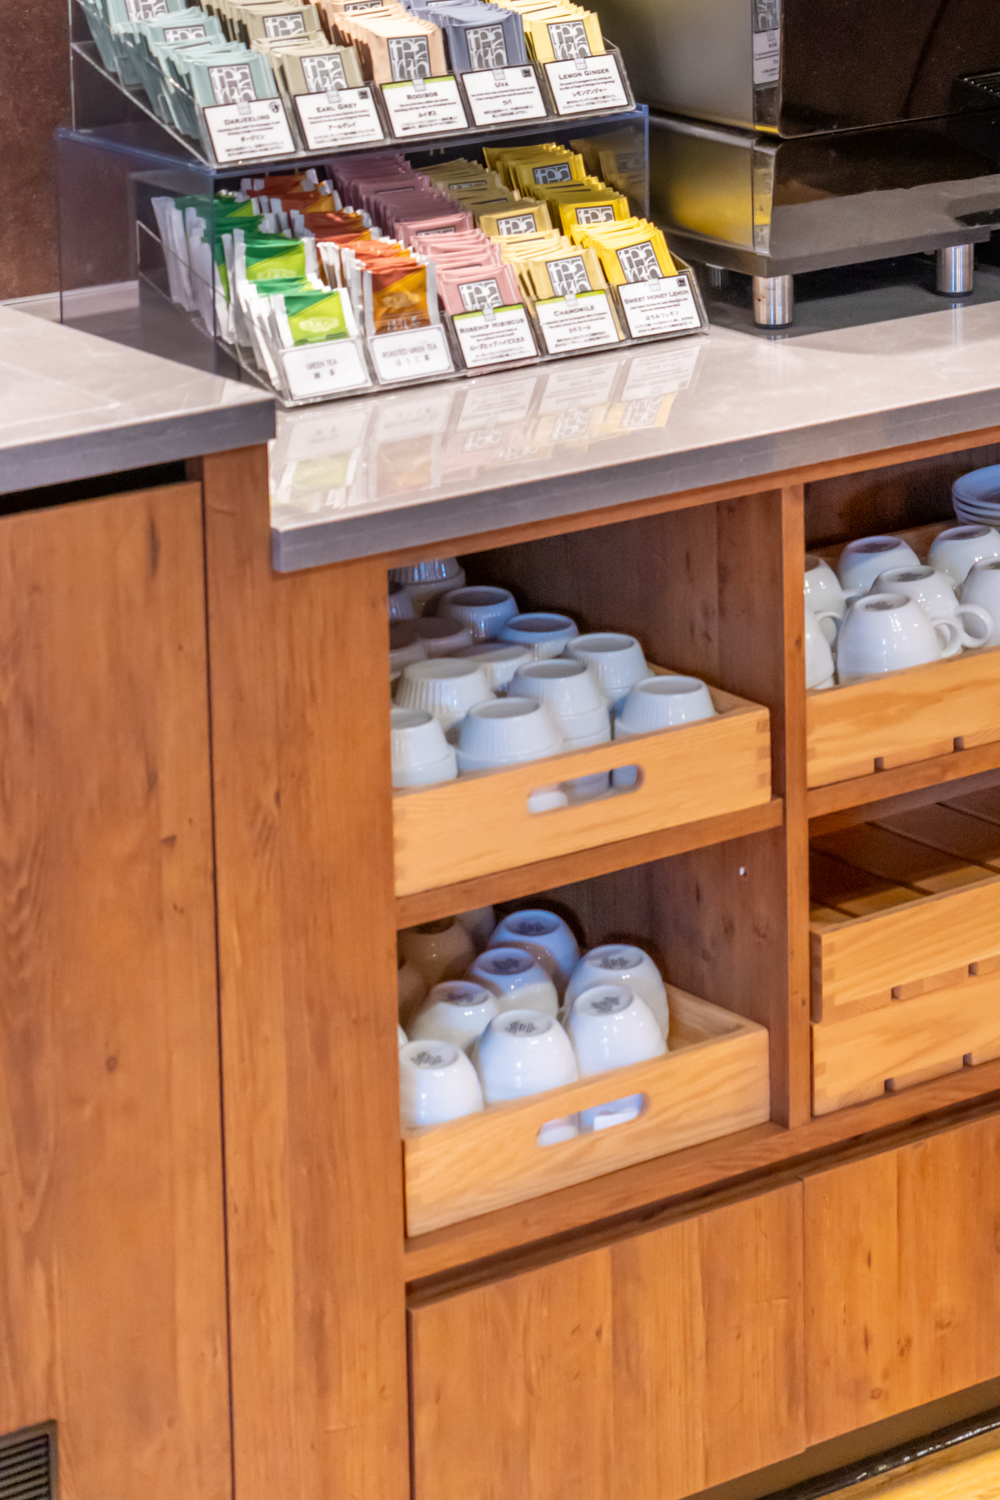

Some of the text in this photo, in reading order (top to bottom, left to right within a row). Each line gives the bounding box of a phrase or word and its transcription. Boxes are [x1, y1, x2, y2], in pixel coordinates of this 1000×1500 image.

[558, 68, 610, 80] LEMON GINGER
[338, 102, 358, 110] GREY
[553, 305, 595, 317] CHAMOMILE
